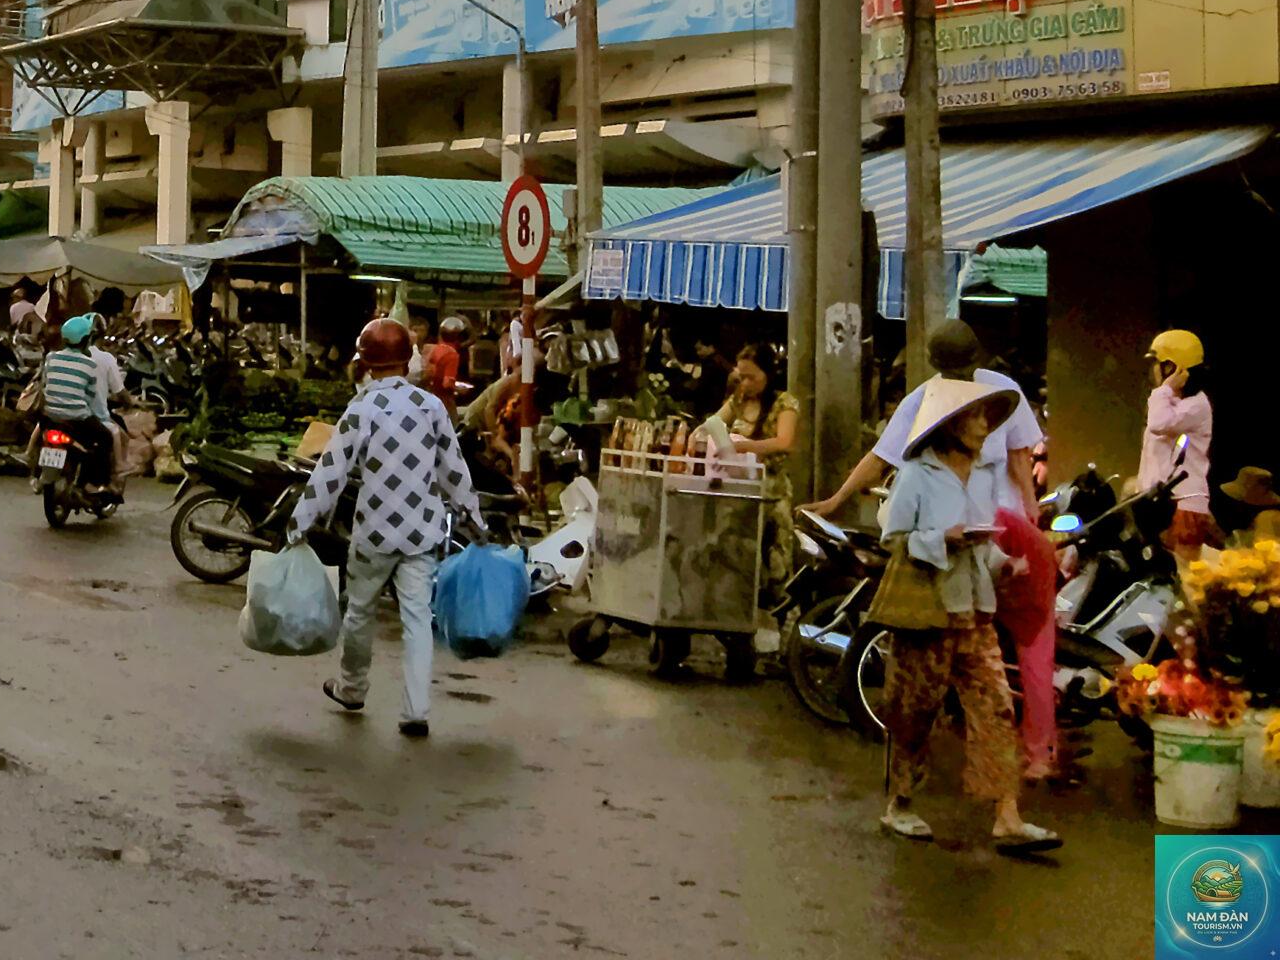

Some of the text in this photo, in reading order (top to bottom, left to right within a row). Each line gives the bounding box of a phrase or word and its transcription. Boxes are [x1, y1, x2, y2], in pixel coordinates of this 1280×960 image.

[1029, 14, 1064, 40] GIA
[1042, 55, 1058, 74] &
[1012, 86, 1048, 100] 0903
